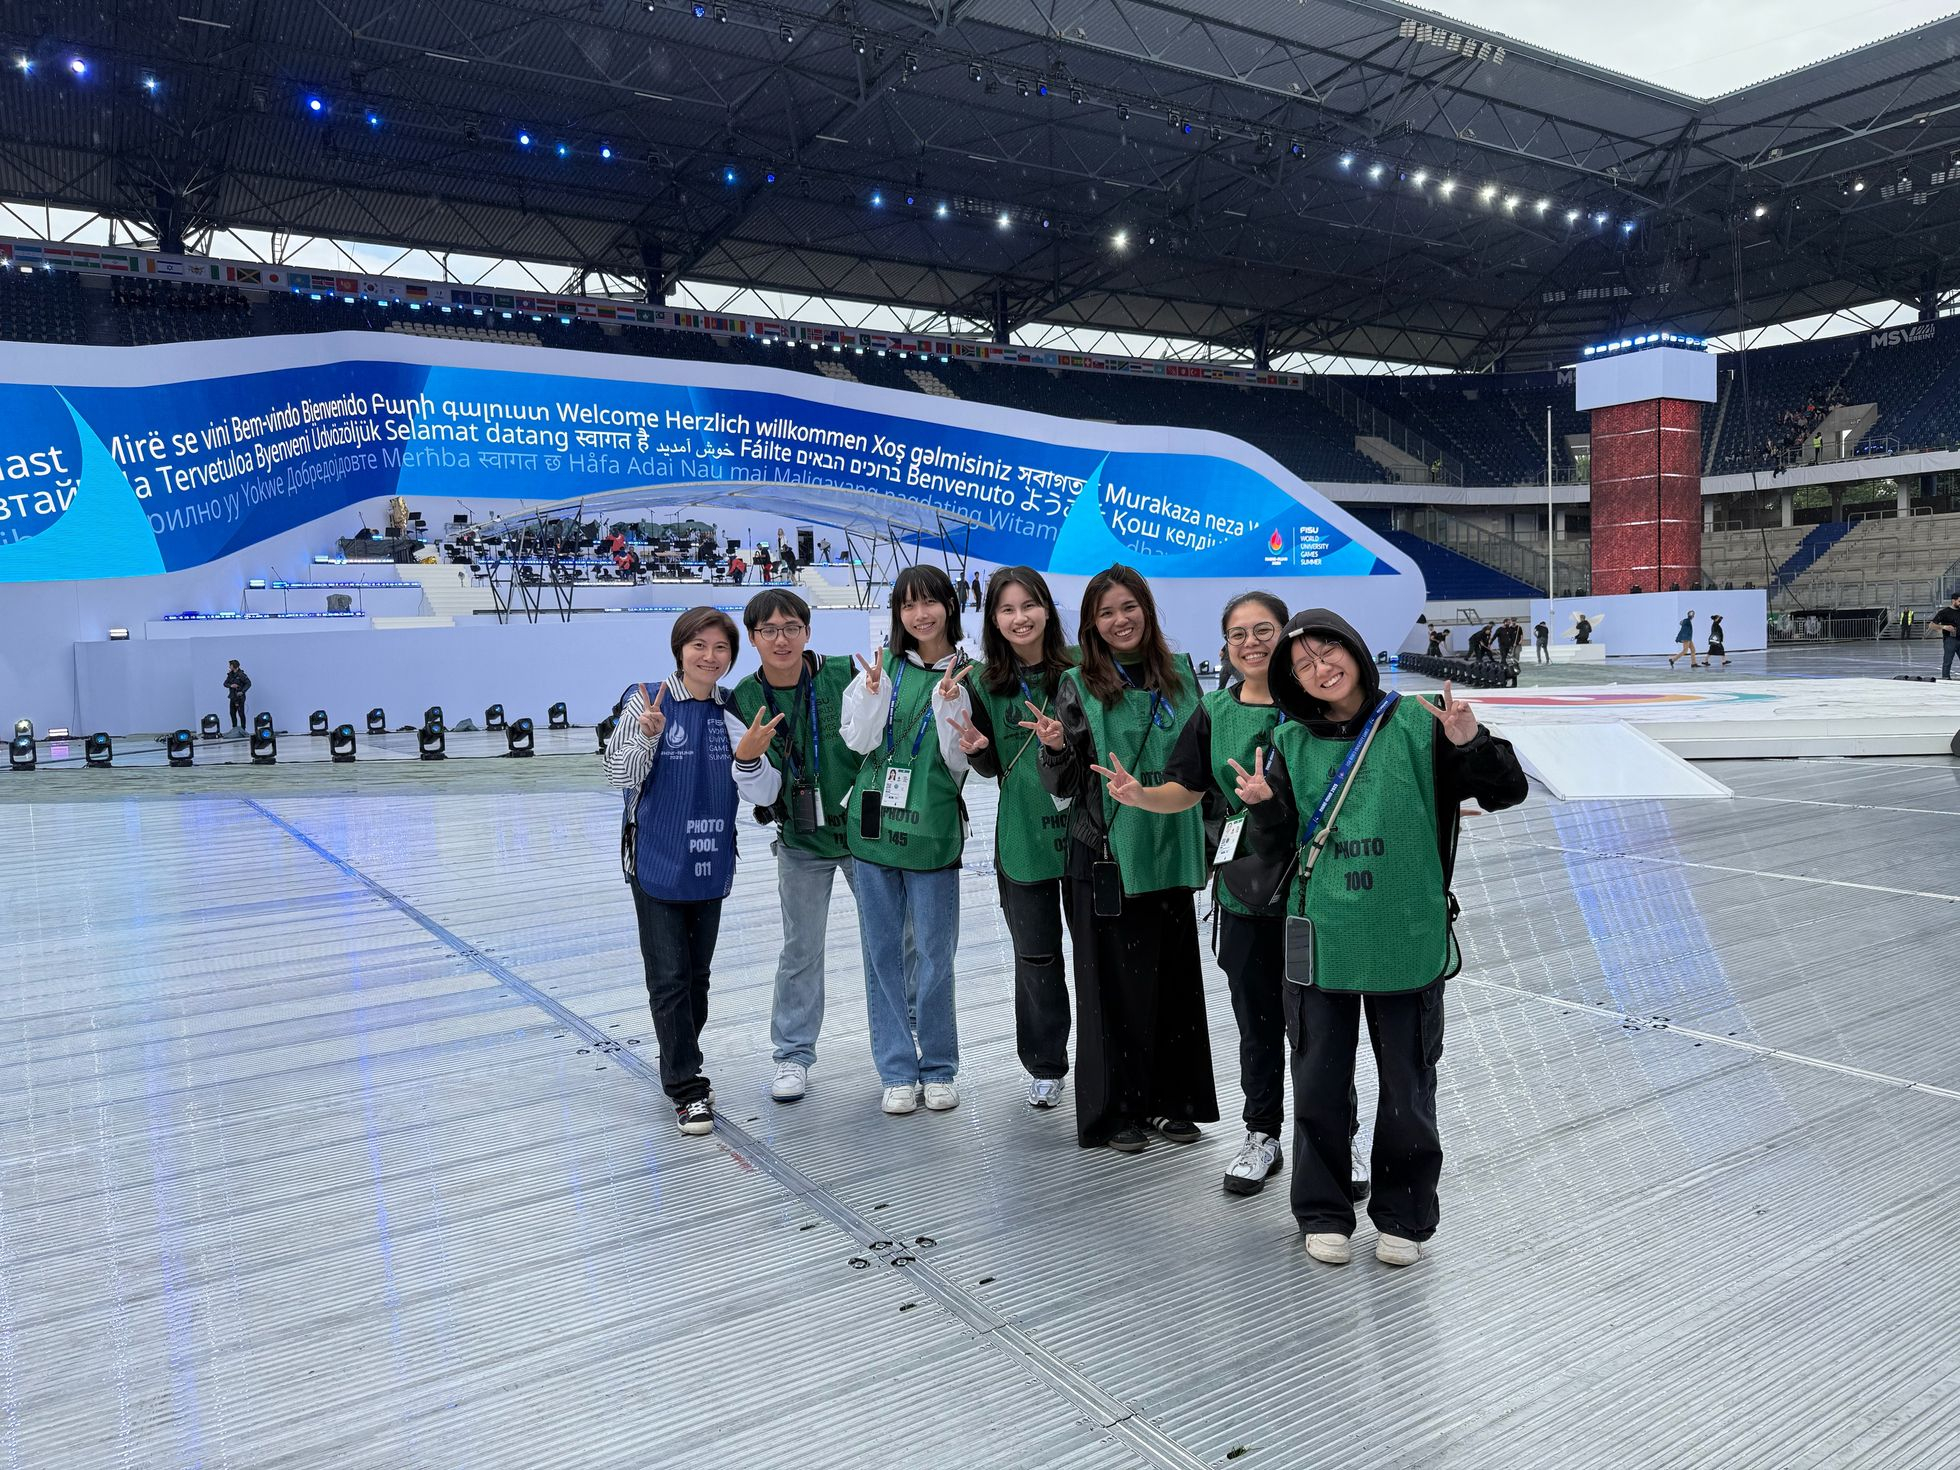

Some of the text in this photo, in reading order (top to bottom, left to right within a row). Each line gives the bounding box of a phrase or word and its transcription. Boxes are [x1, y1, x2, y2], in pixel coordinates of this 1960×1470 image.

[171, 432, 199, 456] se
[200, 418, 231, 451] vini
[231, 402, 300, 443] Bem-vindo
[301, 392, 367, 425] Bienvenido
[155, 450, 254, 494] Tervetuloa
[254, 430, 311, 474] Byenveni
[312, 418, 382, 451] Üdvözöljük
[385, 419, 479, 442] Selamat
[486, 422, 569, 452] datang
[556, 402, 1013, 481] Welcome Herzlich willkommen Xoş gəlmisiniz
[740, 439, 792, 463] Fáilte
[0, 446, 69, 481] ast
[796, 450, 901, 483] ברוכים הבאים
[240, 477, 285, 508] Yokwe
[569, 452, 620, 474] Håfa
[627, 457, 674, 477] Adai
[681, 459, 723, 479] Nau
[730, 465, 767, 482] mai
[989, 508, 1058, 542] Witam
[906, 467, 1015, 507] Benvenuto
[1105, 482, 1244, 537] Murakaza neza
[1112, 509, 1161, 537] Қош
[1165, 525, 1229, 552] келді
[686, 819, 725, 834] PHOTO
[881, 807, 920, 824] PHOTO
[689, 838, 718, 853] POOL
[888, 830, 908, 847] 145
[1334, 838, 1385, 859] PHOTO
[694, 862, 712, 877] 011
[1344, 870, 1373, 891] 100
